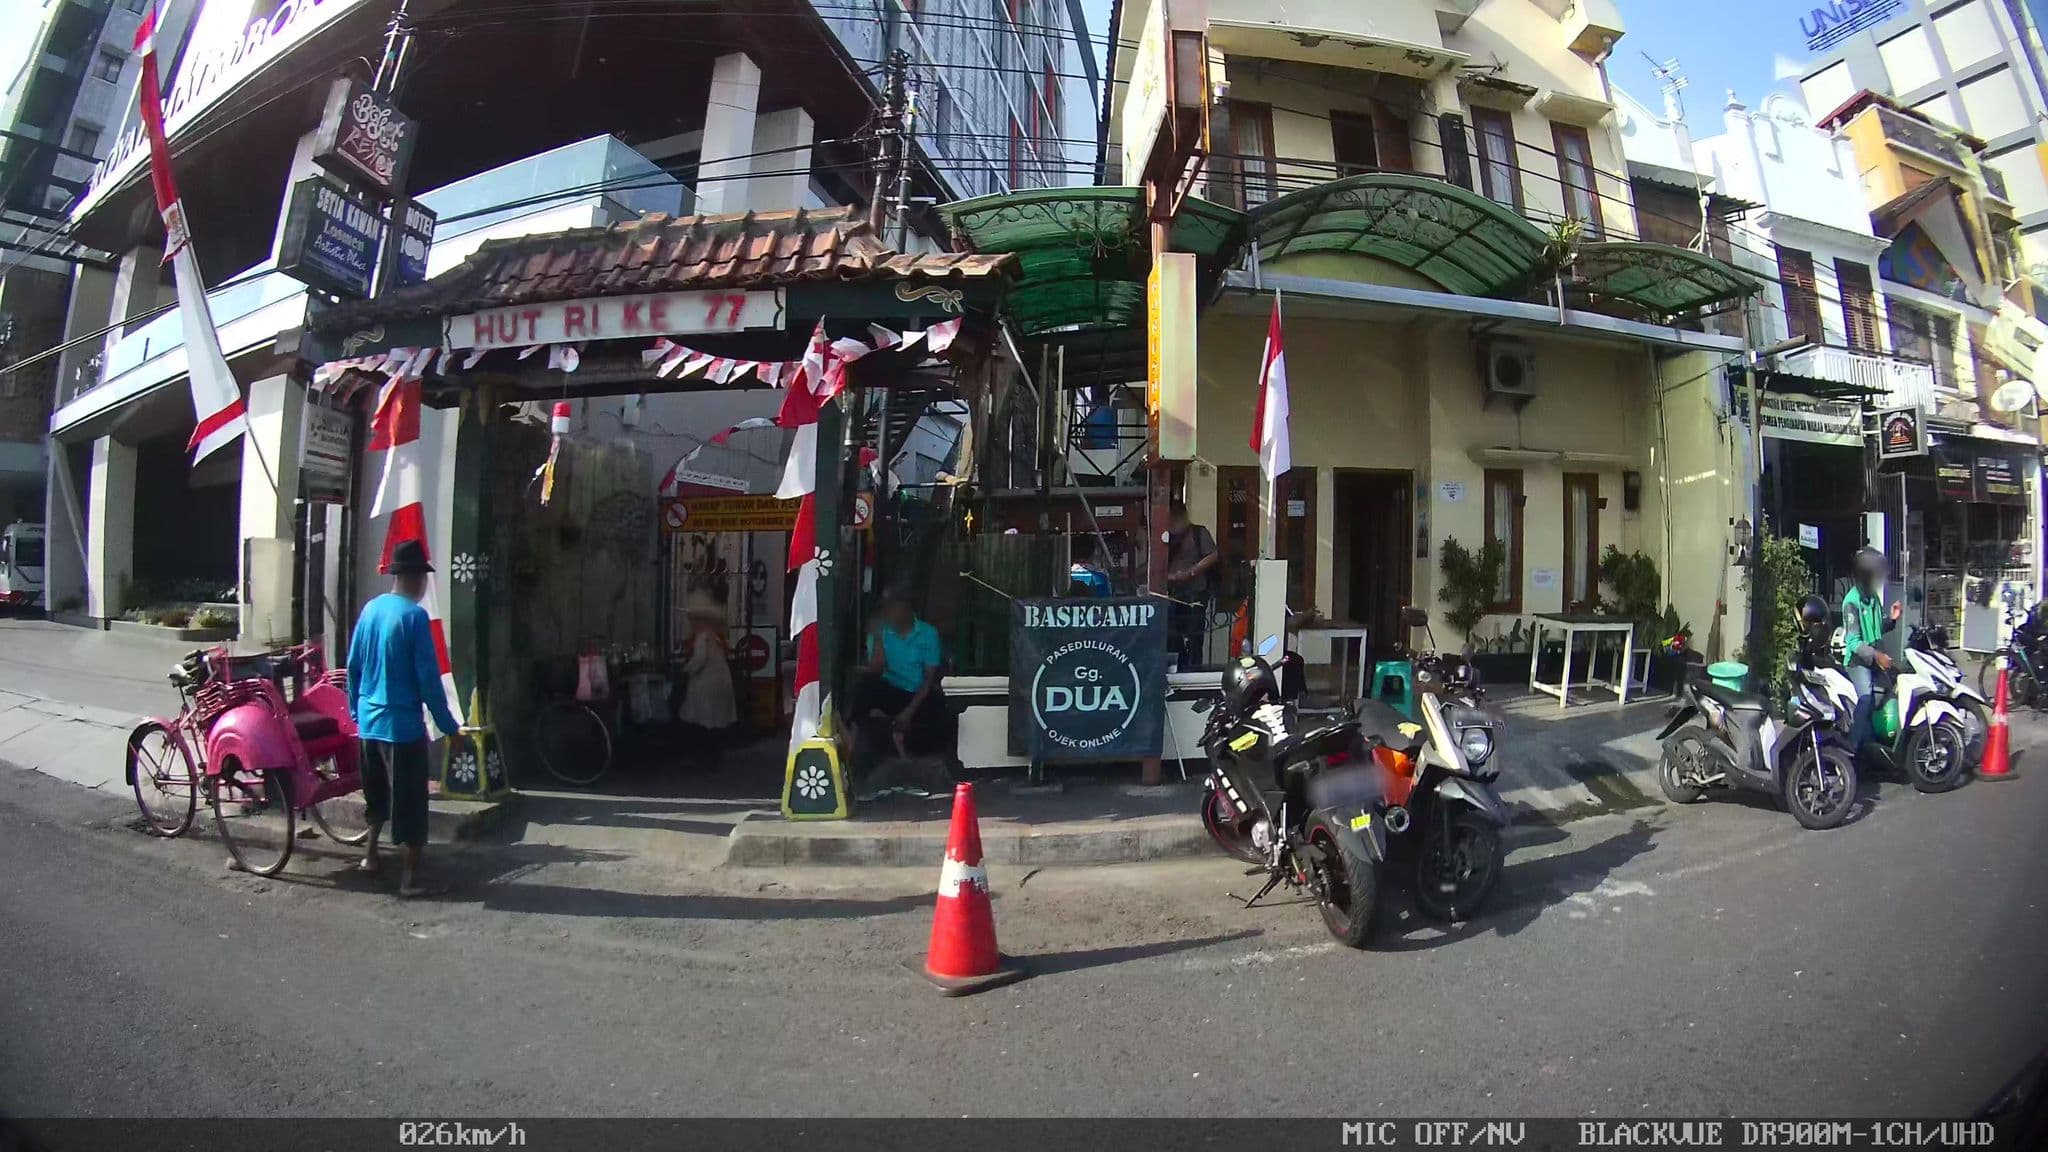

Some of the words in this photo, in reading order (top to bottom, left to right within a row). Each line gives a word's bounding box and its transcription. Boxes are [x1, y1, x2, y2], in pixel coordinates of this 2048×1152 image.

[317, 187, 345, 221] SETIA
[346, 204, 380, 240] KAWAN
[406, 206, 433, 237] HOTEL
[474, 312, 539, 345] HUT
[565, 306, 599, 337] RI
[624, 297, 668, 331] KE
[704, 295, 745, 327] 77
[1024, 605, 1155, 628] BASECAMP
[1046, 640, 1129, 665] PASEDULURAN
[1074, 666, 1103, 682] Gg.
[1045, 686, 1129, 712] DUA
[1048, 729, 1078, 748] OJEK
[1079, 728, 1122, 749] ONLINE
